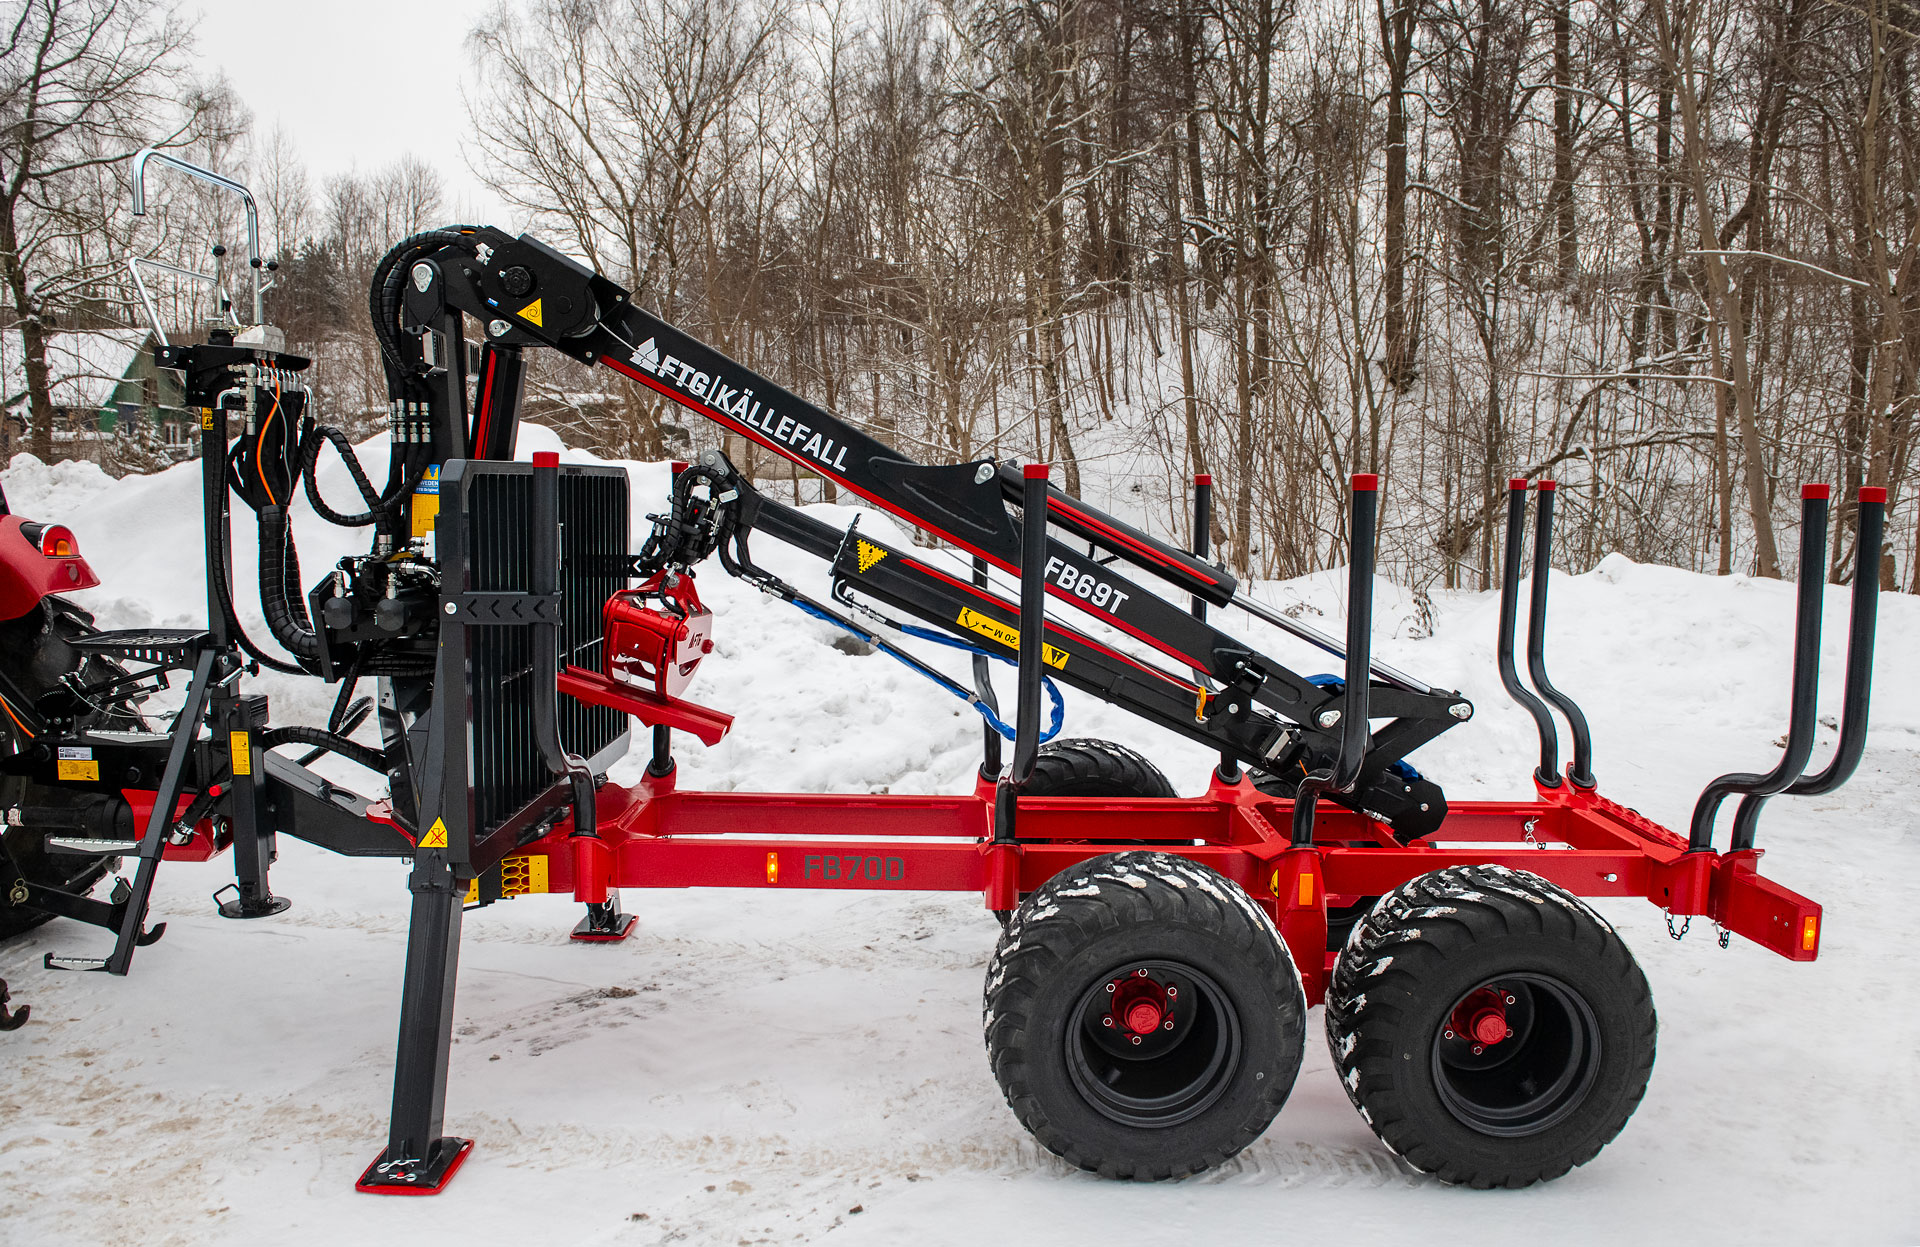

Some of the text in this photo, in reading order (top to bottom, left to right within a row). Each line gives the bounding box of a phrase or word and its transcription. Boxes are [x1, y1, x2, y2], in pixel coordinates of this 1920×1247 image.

[657, 354, 848, 473] FTG KÄLLEFALL
[1044, 555, 1130, 614] FB69T
[1004, 633, 1017, 644] 20
[804, 855, 904, 881] FB70D
